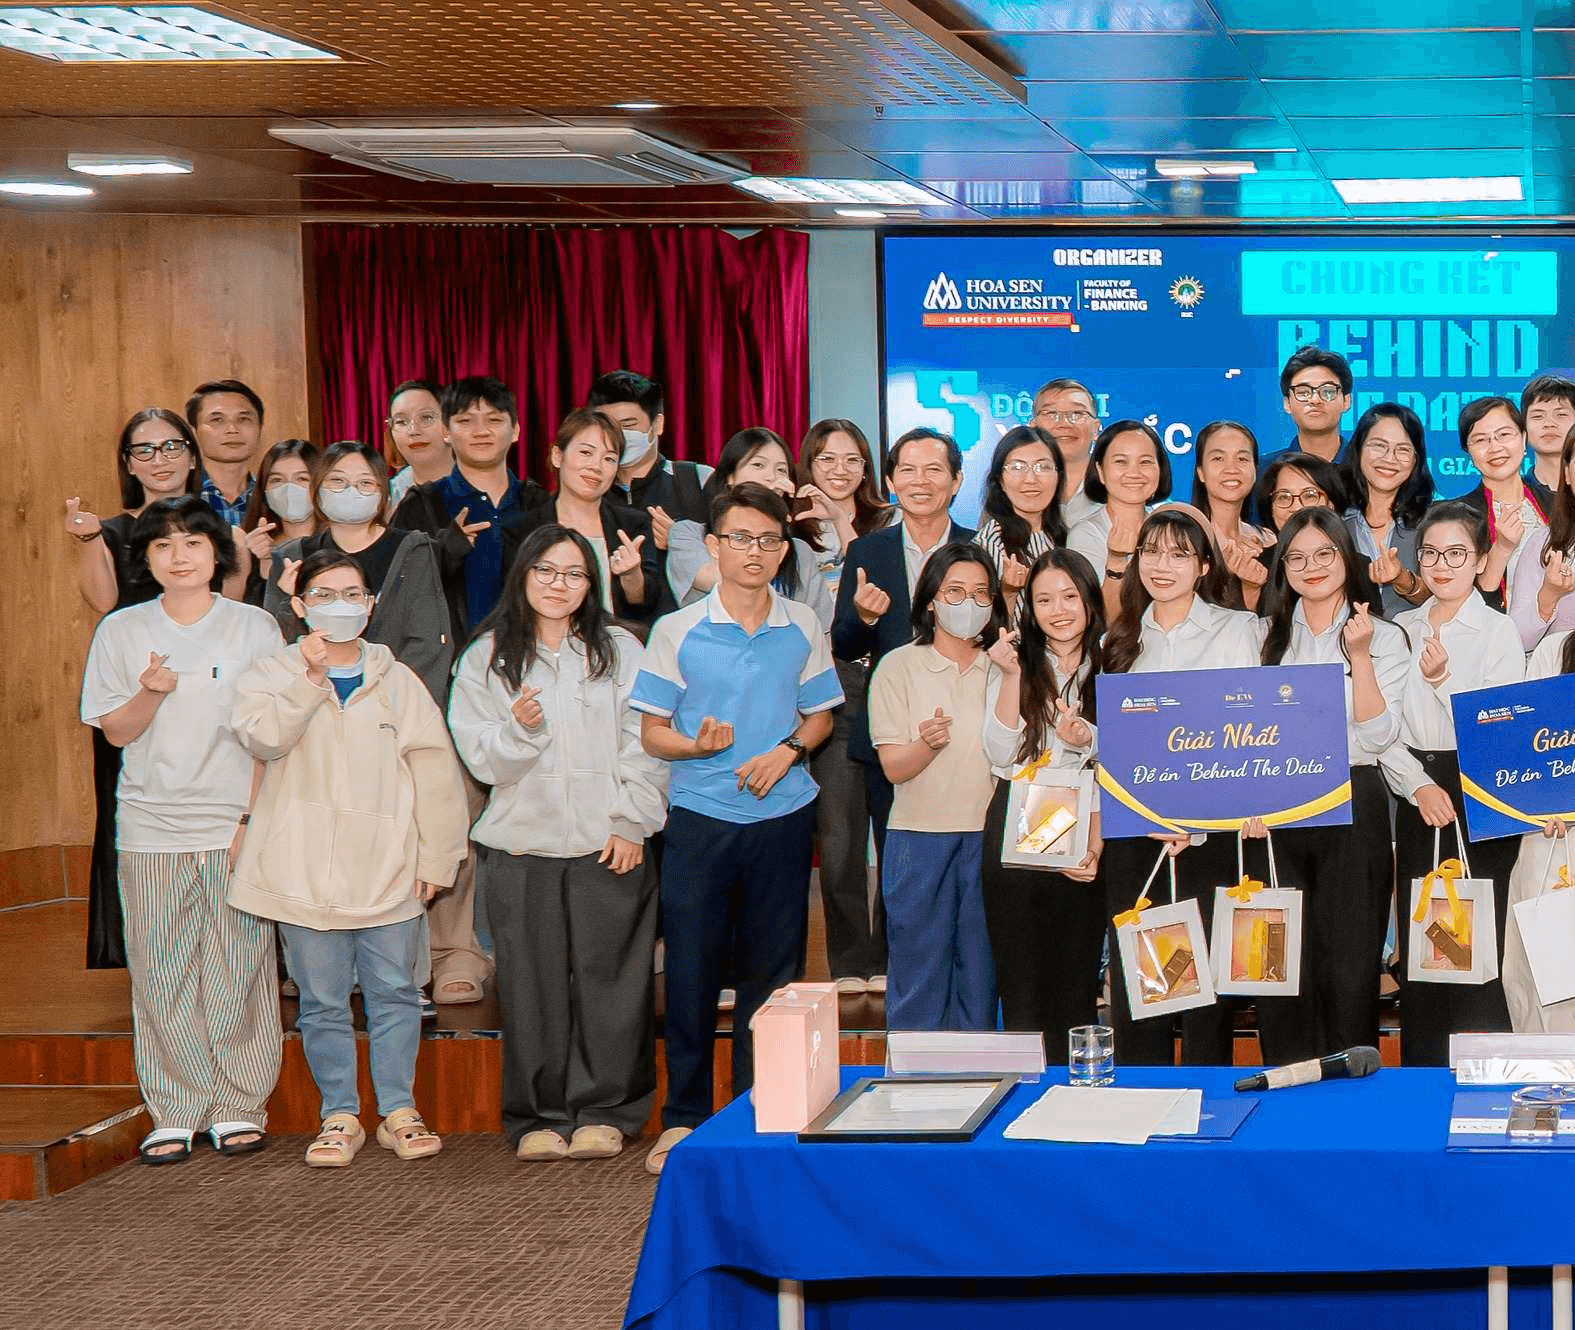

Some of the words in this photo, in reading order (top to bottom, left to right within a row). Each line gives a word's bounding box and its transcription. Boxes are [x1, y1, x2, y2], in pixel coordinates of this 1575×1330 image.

[1053, 248, 1163, 266] ORGANIZER
[1083, 279, 1118, 288] FACULTY
[1119, 279, 1132, 288] OF
[1281, 260, 1425, 294] CHUNG
[966, 279, 1006, 293] HOA
[1008, 279, 1043, 293] SEN
[1083, 288, 1138, 299] FINANCE
[966, 296, 1073, 311] UNIVERSITY
[1091, 300, 1148, 312] BANKING
[948, 315, 992, 324] RESPECT
[996, 315, 1049, 324] DIVERSITY
[1278, 319, 1539, 378] BEHIND
[1167, 725, 1215, 752] Giải
[1223, 723, 1280, 749] Nhất
[1133, 765, 1154, 785] Đề
[1158, 768, 1180, 782] án
[1252, 758, 1280, 778] The
[1495, 769, 1518, 788] Đề
[1521, 767, 1542, 783] án
